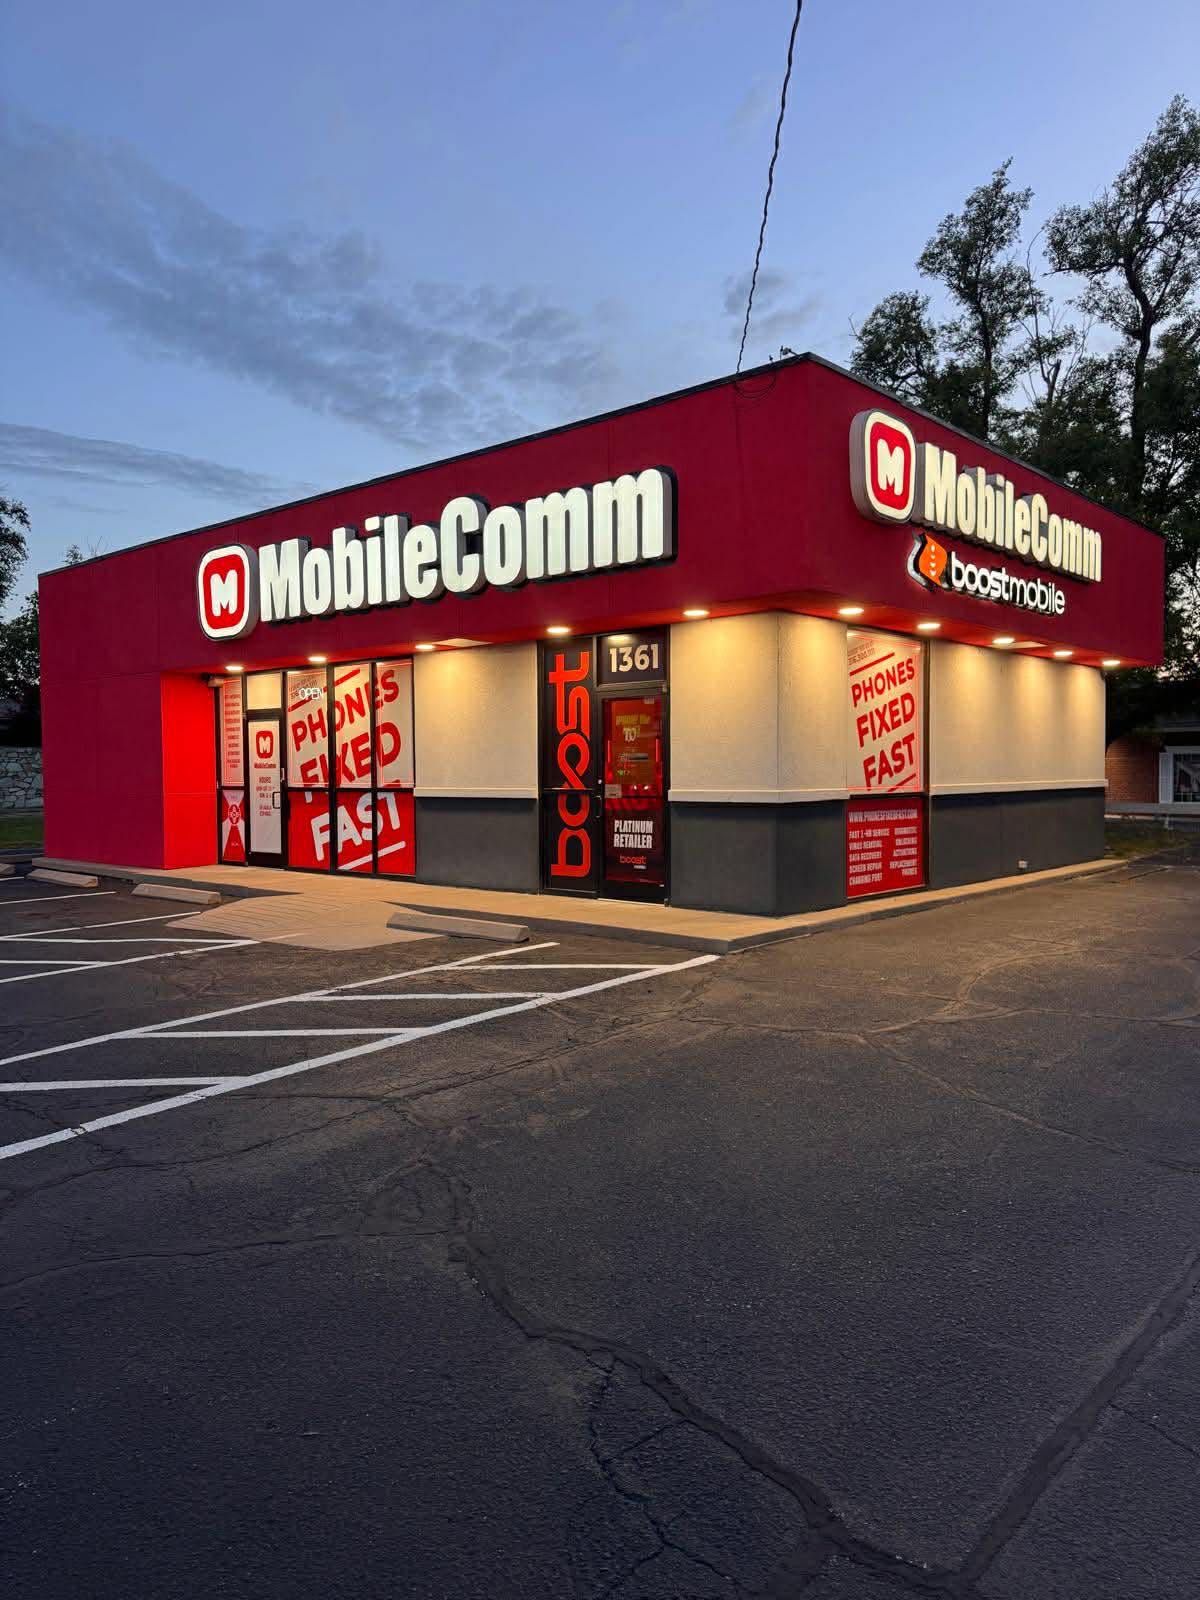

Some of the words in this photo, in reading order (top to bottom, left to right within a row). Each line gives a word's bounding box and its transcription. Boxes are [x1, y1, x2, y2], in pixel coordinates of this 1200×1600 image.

[923, 441, 1102, 583] MobileComm
[257, 468, 665, 622] MobileComm
[609, 643, 659, 673] 1361
[851, 657, 915, 708] PHONES
[291, 669, 400, 752] PHONES
[856, 692, 915, 748] FIXED
[300, 721, 401, 803] FIXED
[548, 651, 591, 877] boost
[863, 732, 915, 791] FAST
[311, 779, 401, 861] FAST
[613, 834, 653, 849] RETAILER
[614, 819, 653, 834] PLATINUM
[619, 854, 647, 865] boost
